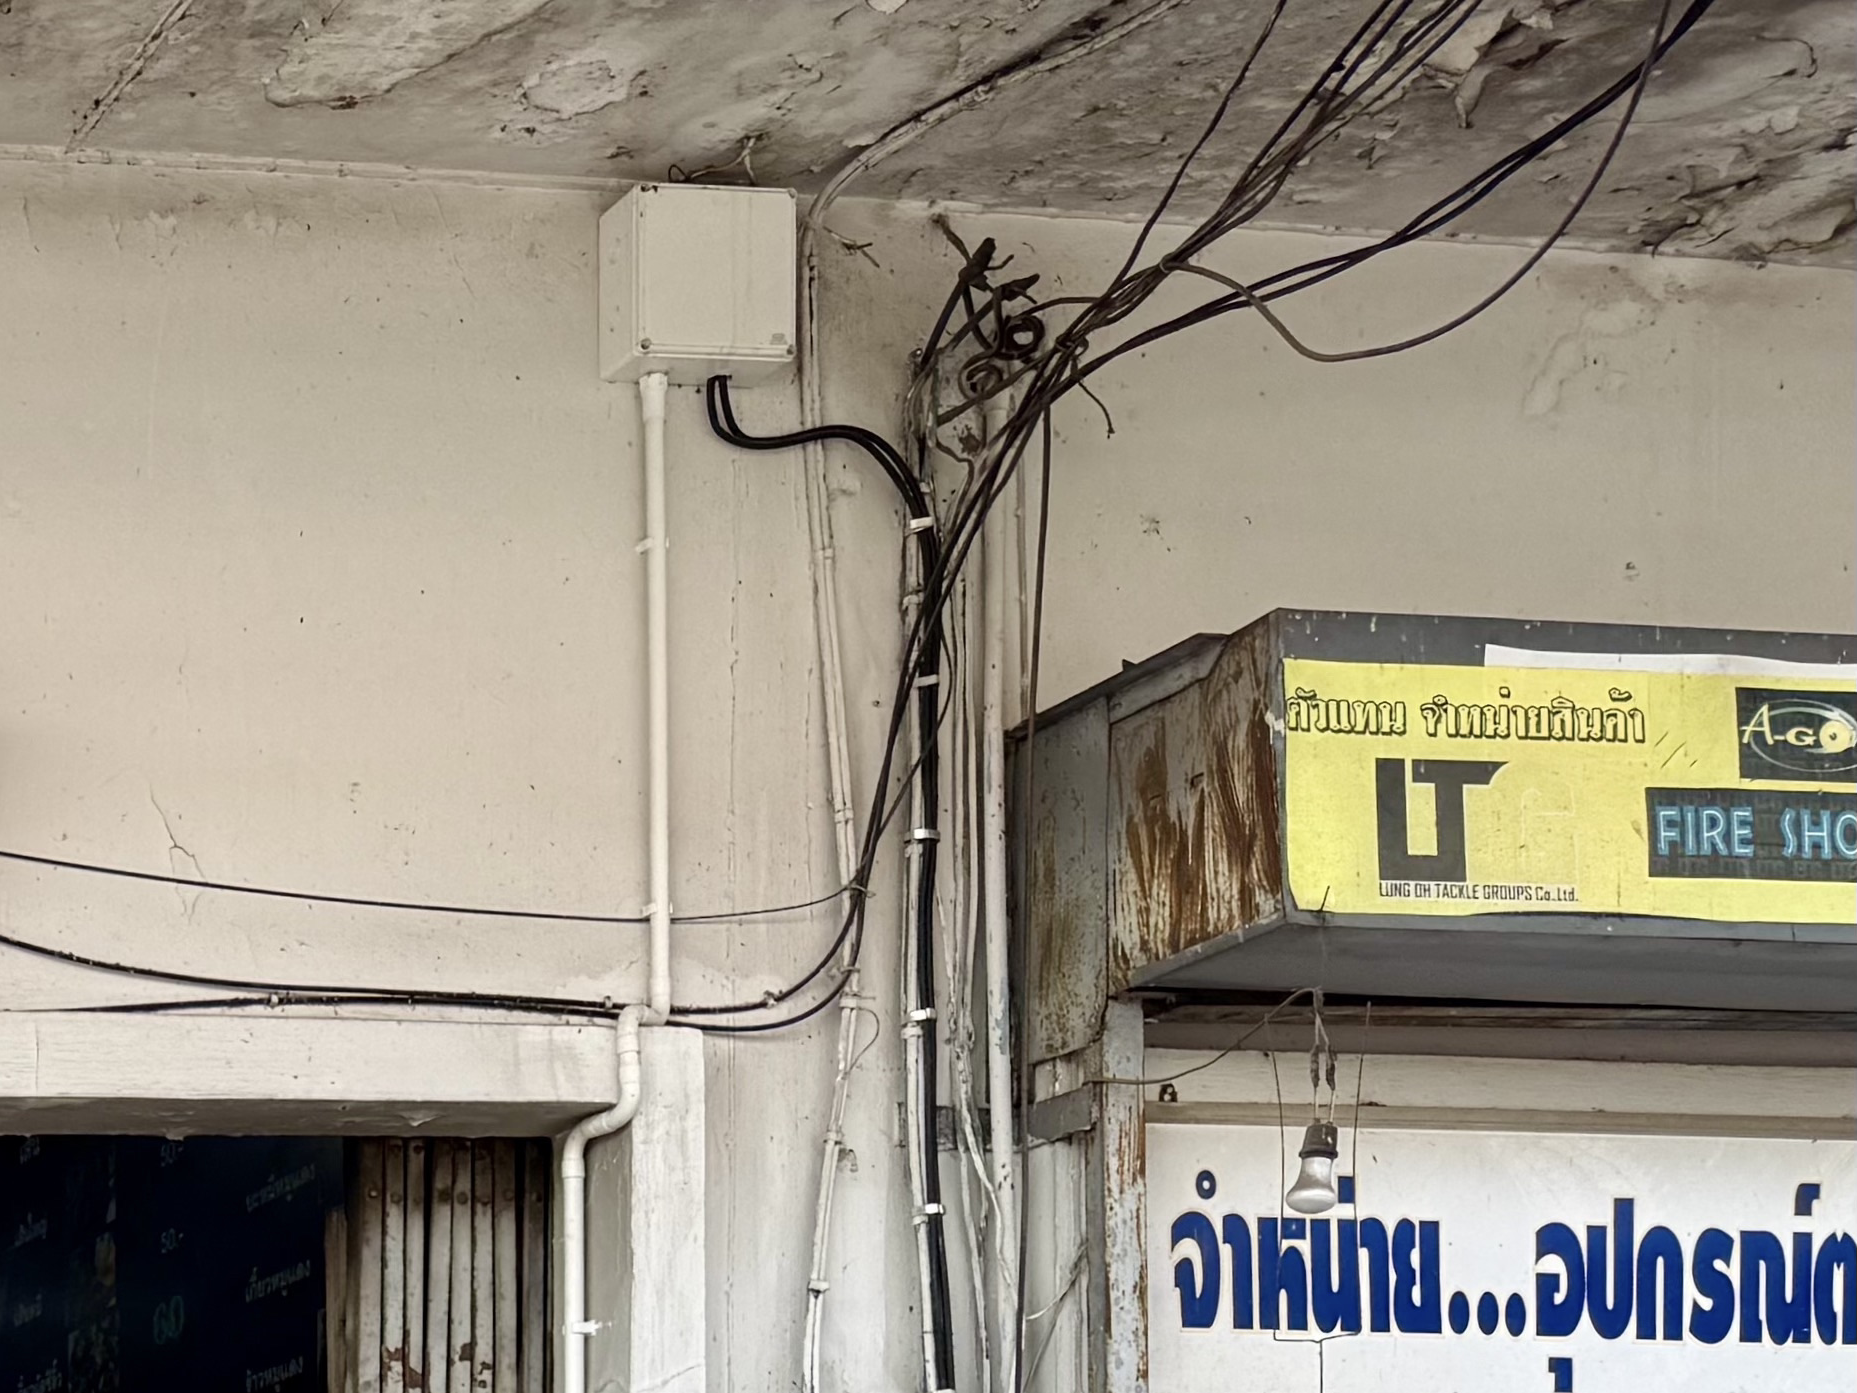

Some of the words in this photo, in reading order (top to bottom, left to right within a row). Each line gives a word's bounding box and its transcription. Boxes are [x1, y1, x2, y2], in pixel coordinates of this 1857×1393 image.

[1285, 687, 1406, 736] ตัวแทน
[1421, 687, 1646, 743] จำหน่ายสินค้า
[1655, 805, 1755, 859] FIRE
[1379, 881, 1410, 899] LUNG
[1434, 883, 1480, 900] TACKLE
[1482, 884, 1533, 902] GROUPS
